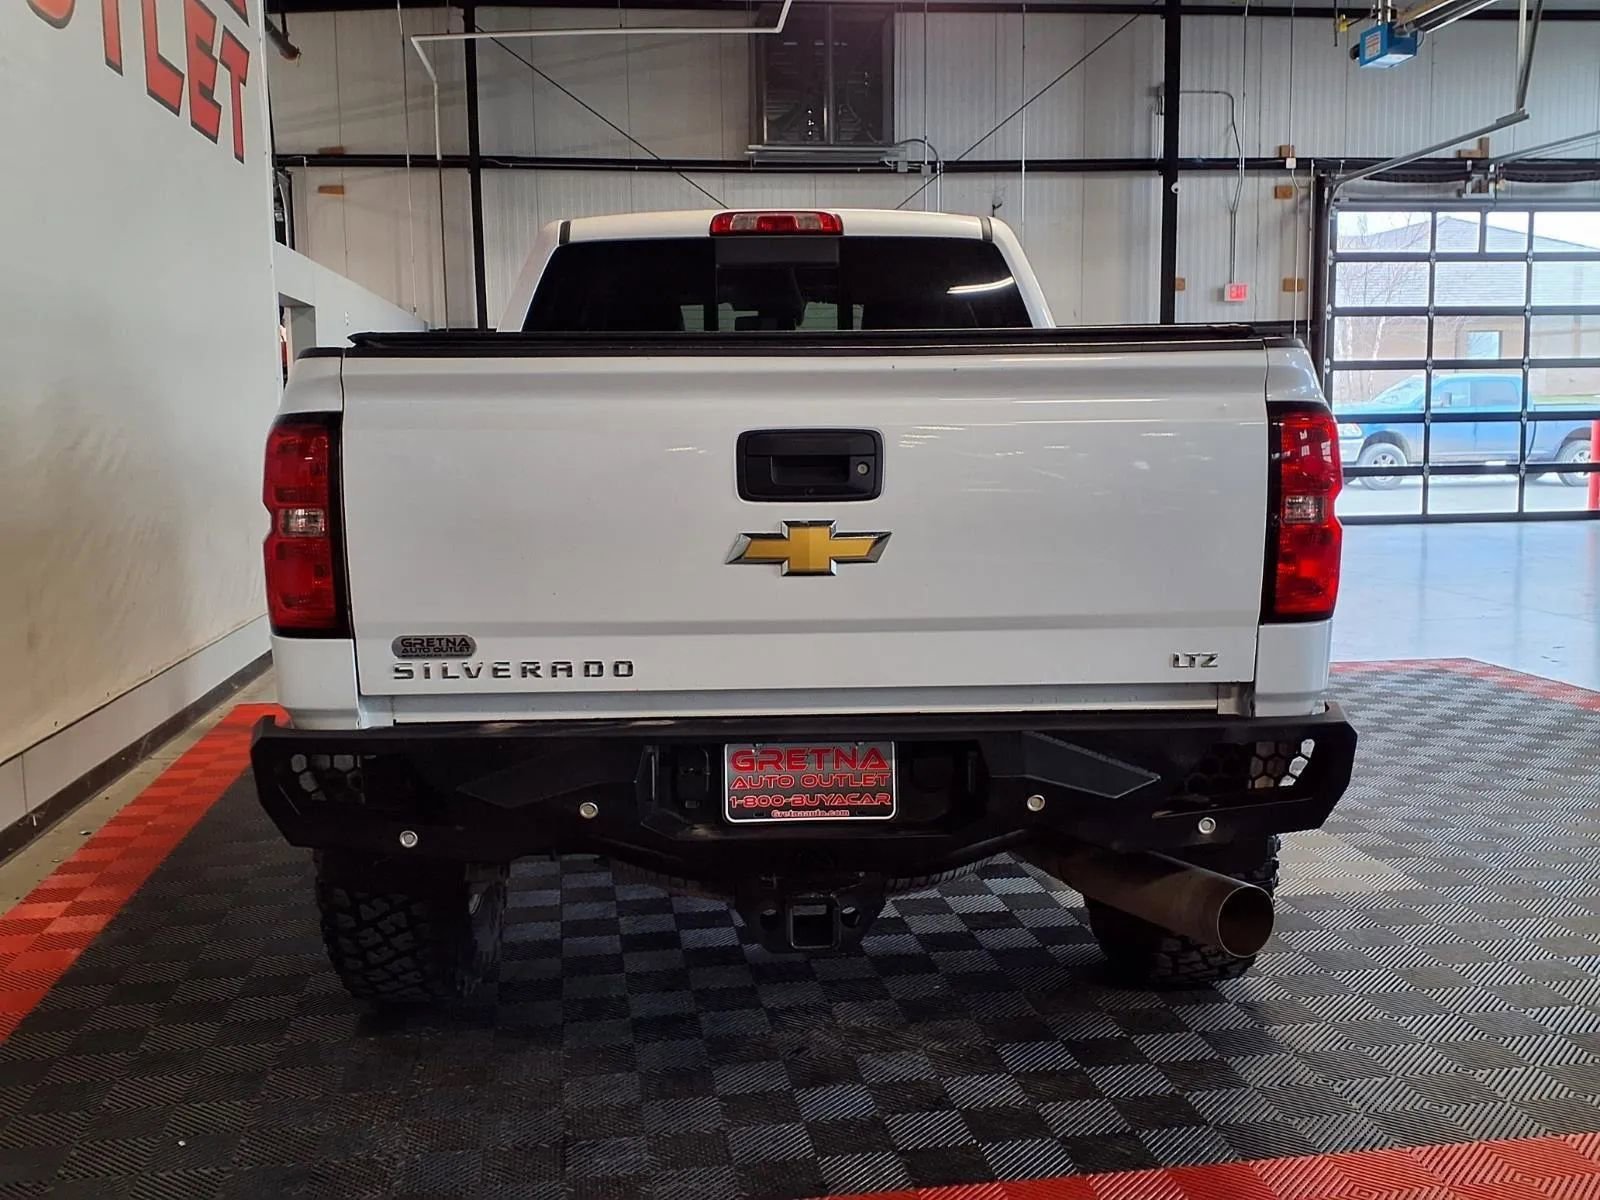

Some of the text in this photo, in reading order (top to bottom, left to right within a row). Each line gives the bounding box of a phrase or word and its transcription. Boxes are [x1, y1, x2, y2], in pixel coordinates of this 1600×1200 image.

[401, 637, 471, 648] GRETNA
[1172, 652, 1218, 668] LTZ
[393, 660, 634, 680] SILVERADO
[730, 747, 890, 772] GRETNA
[730, 773, 891, 790] AUTO OUTLET
[730, 793, 892, 808] 1-800-BUYACAR
